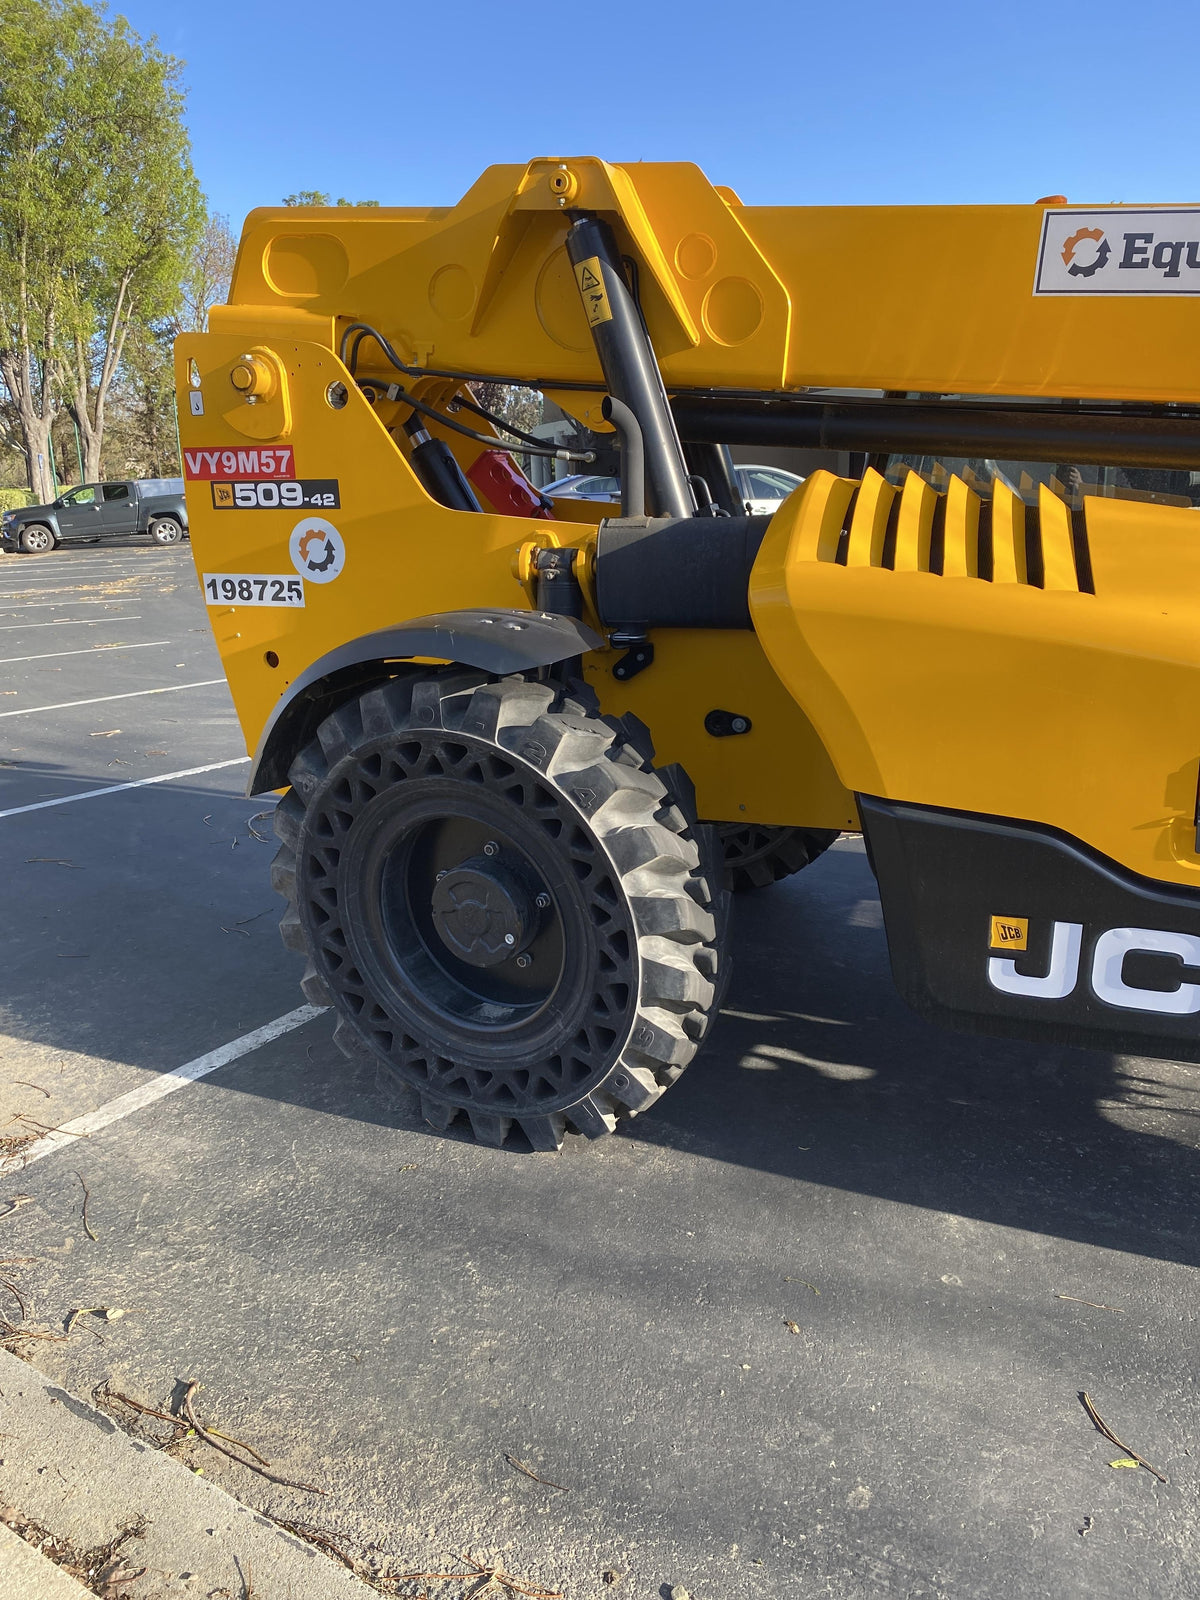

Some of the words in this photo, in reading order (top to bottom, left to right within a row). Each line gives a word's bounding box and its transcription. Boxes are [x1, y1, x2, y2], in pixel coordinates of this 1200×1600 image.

[184, 449, 291, 475] VY9M57
[234, 482, 335, 507] 509-42
[206, 578, 303, 602] 198725
[1000, 924, 1021, 941] JCB
